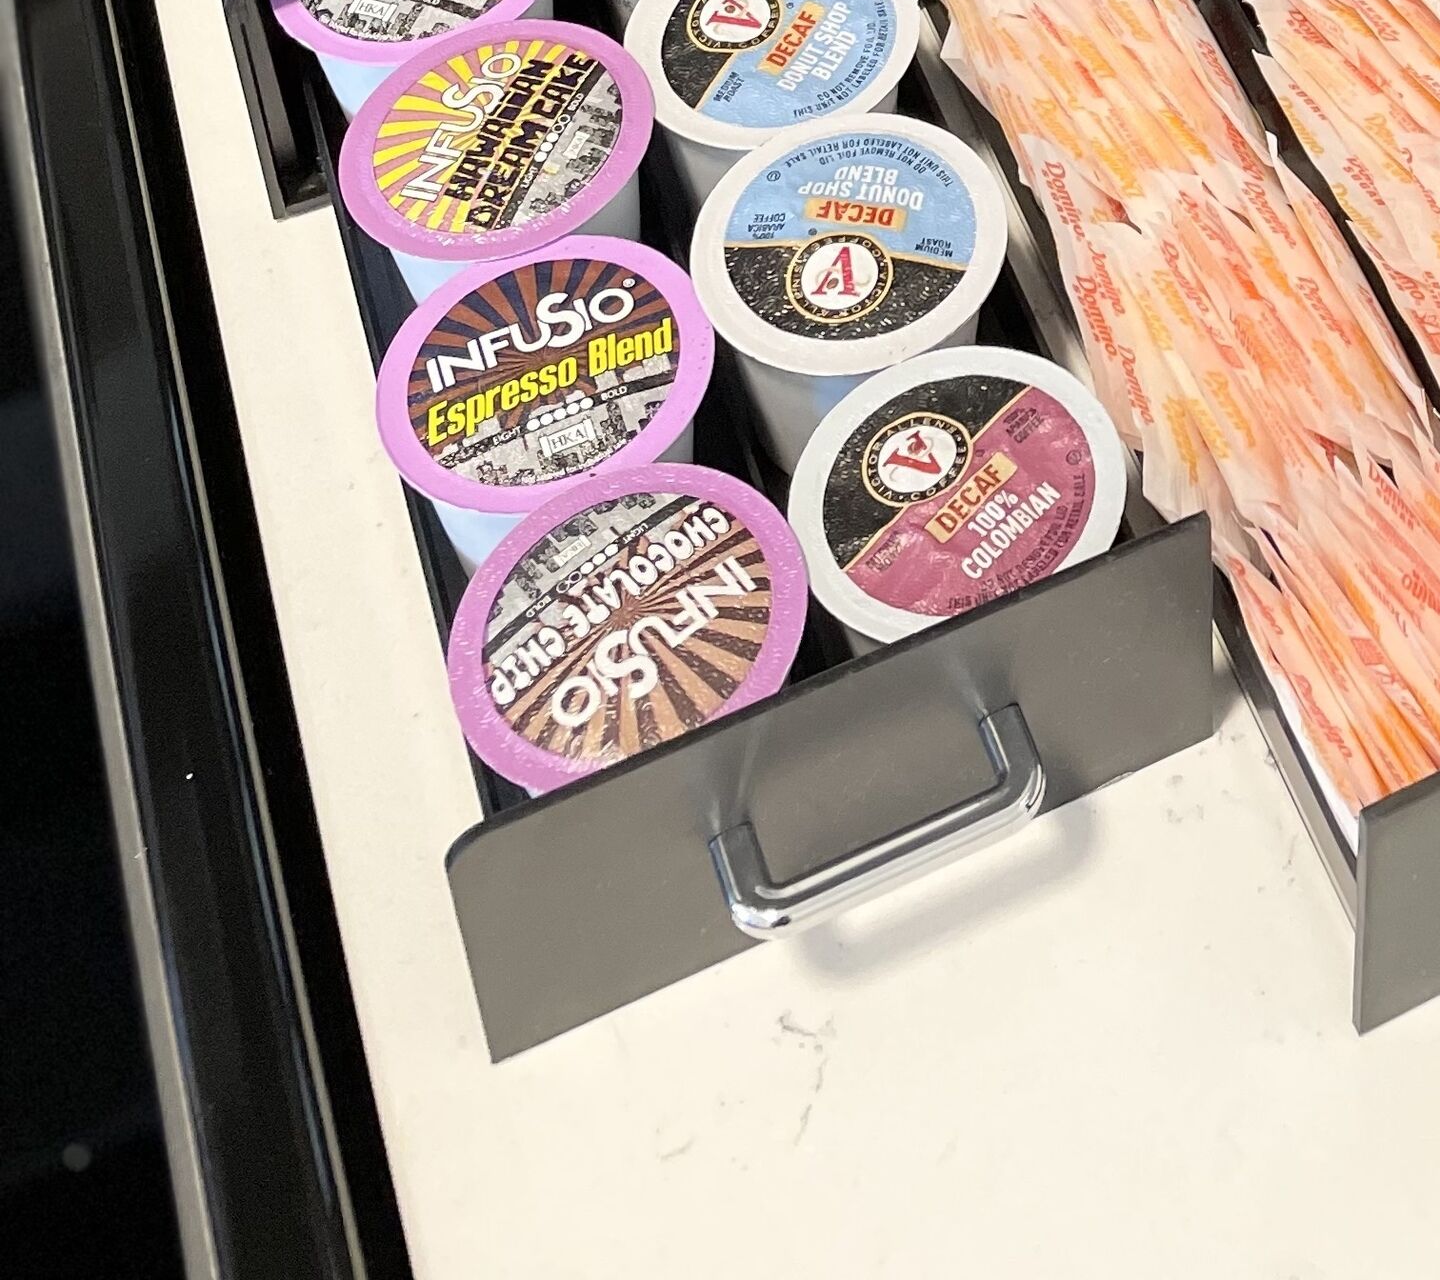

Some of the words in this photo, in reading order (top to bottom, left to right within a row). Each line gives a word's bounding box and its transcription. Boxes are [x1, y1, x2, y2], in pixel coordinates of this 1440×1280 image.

[766, 10, 816, 67] DECAF
[777, 44, 824, 91] DONUT
[814, 1, 852, 46] SHOP
[811, 30, 856, 80] BLEND
[401, 53, 521, 202] INFUSIO
[1288, 83, 1327, 121] SUGAR
[465, 118, 550, 228] DREAM
[532, 52, 597, 120] CAKE
[798, 180, 852, 197] SHOP
[835, 165, 898, 183] BLEND
[858, 189, 924, 211] DONUT
[1045, 160, 1085, 243] Domino
[1345, 164, 1386, 207] SUGAR
[816, 199, 895, 226] DECAF
[425, 288, 634, 393] INFUSIO
[1075, 273, 1118, 363] Domino
[426, 356, 577, 447] Espresso
[588, 317, 673, 377] Blend
[1118, 342, 1155, 426] Domino
[492, 426, 521, 445] LIGHT
[601, 386, 627, 400] BOLD
[868, 443, 892, 500] VICTOR
[910, 446, 967, 501] COFFEE
[935, 464, 1002, 534] DECAF
[962, 481, 1061, 579] COLOMBIAN
[968, 490, 1018, 537] 100%
[561, 507, 731, 638] CHOCOLATE
[526, 596, 551, 618] BOLD
[490, 625, 567, 705] CHIP
[550, 556, 757, 728] INFUSIO
